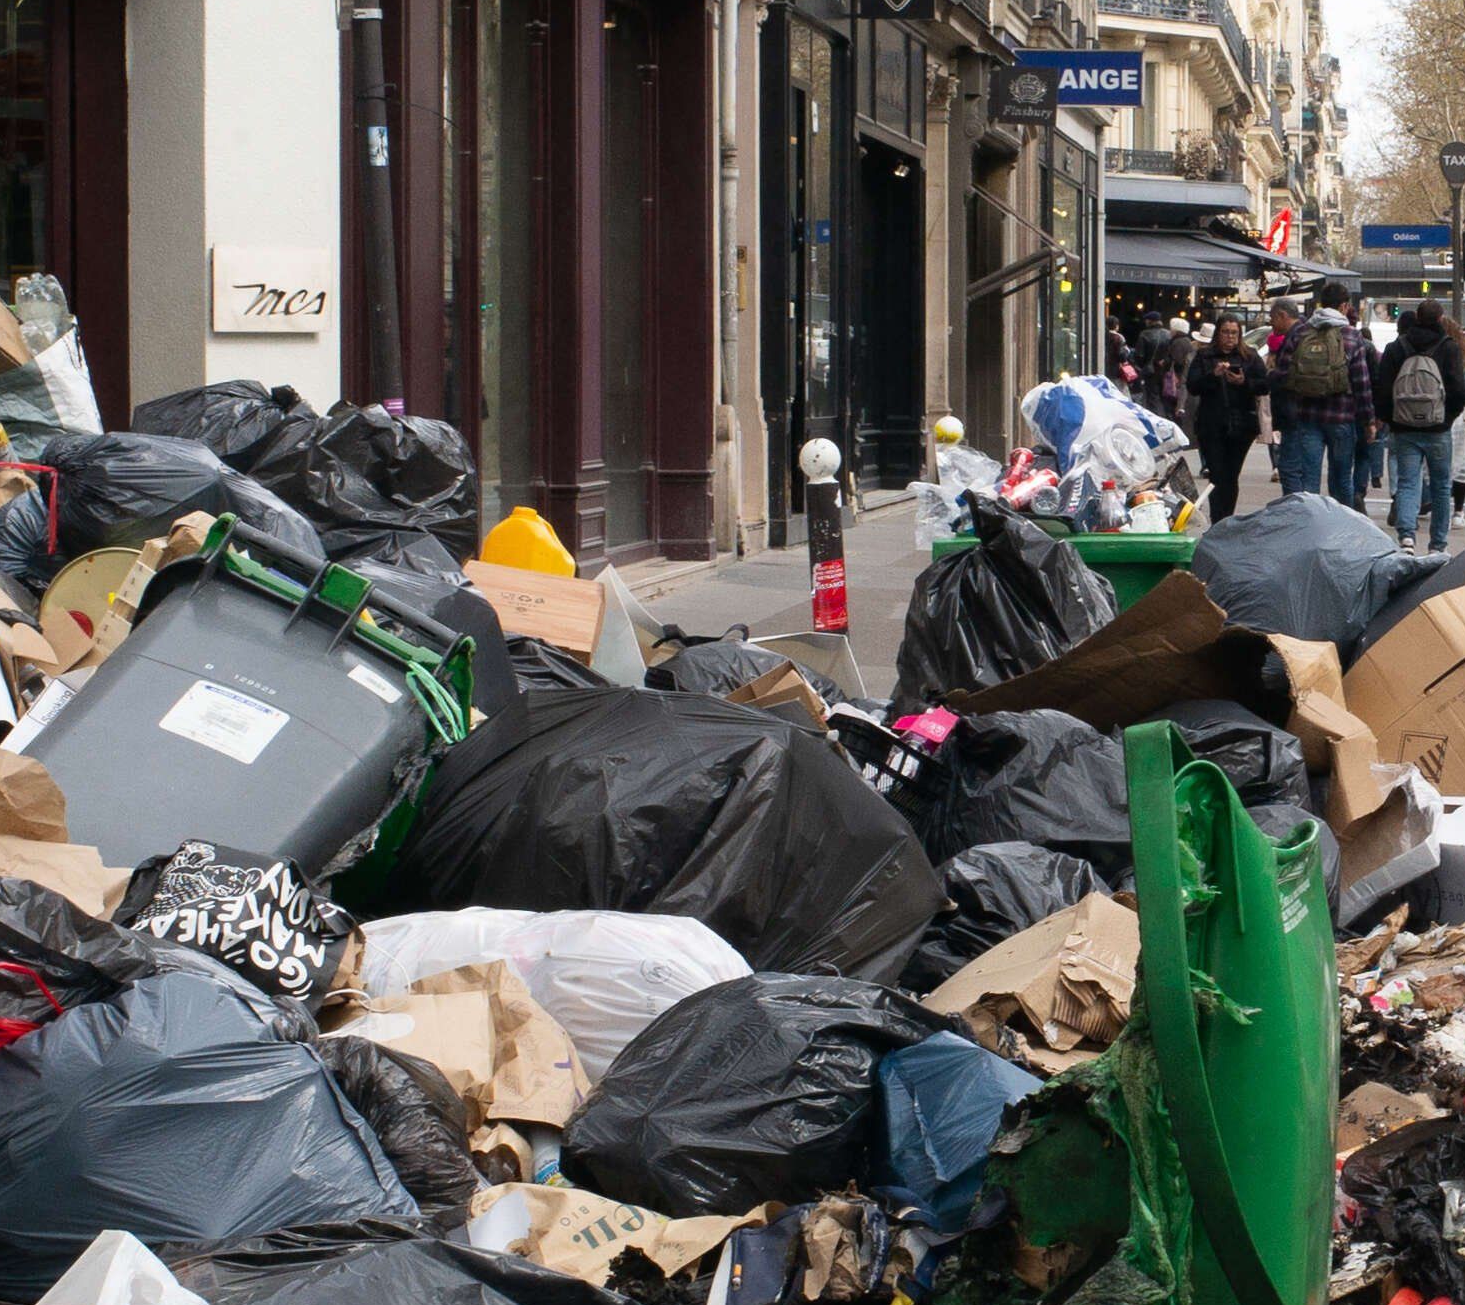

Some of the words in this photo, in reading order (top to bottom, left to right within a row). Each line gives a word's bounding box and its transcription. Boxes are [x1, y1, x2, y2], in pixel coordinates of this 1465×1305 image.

[1058, 68, 1139, 90] ANGE
[1002, 105, 1054, 120] Finsbury
[1392, 231, 1421, 242] Odéon
[232, 282, 327, 317] mcs
[41, 689, 77, 725] Smoking
[131, 908, 247, 952] AHEA
